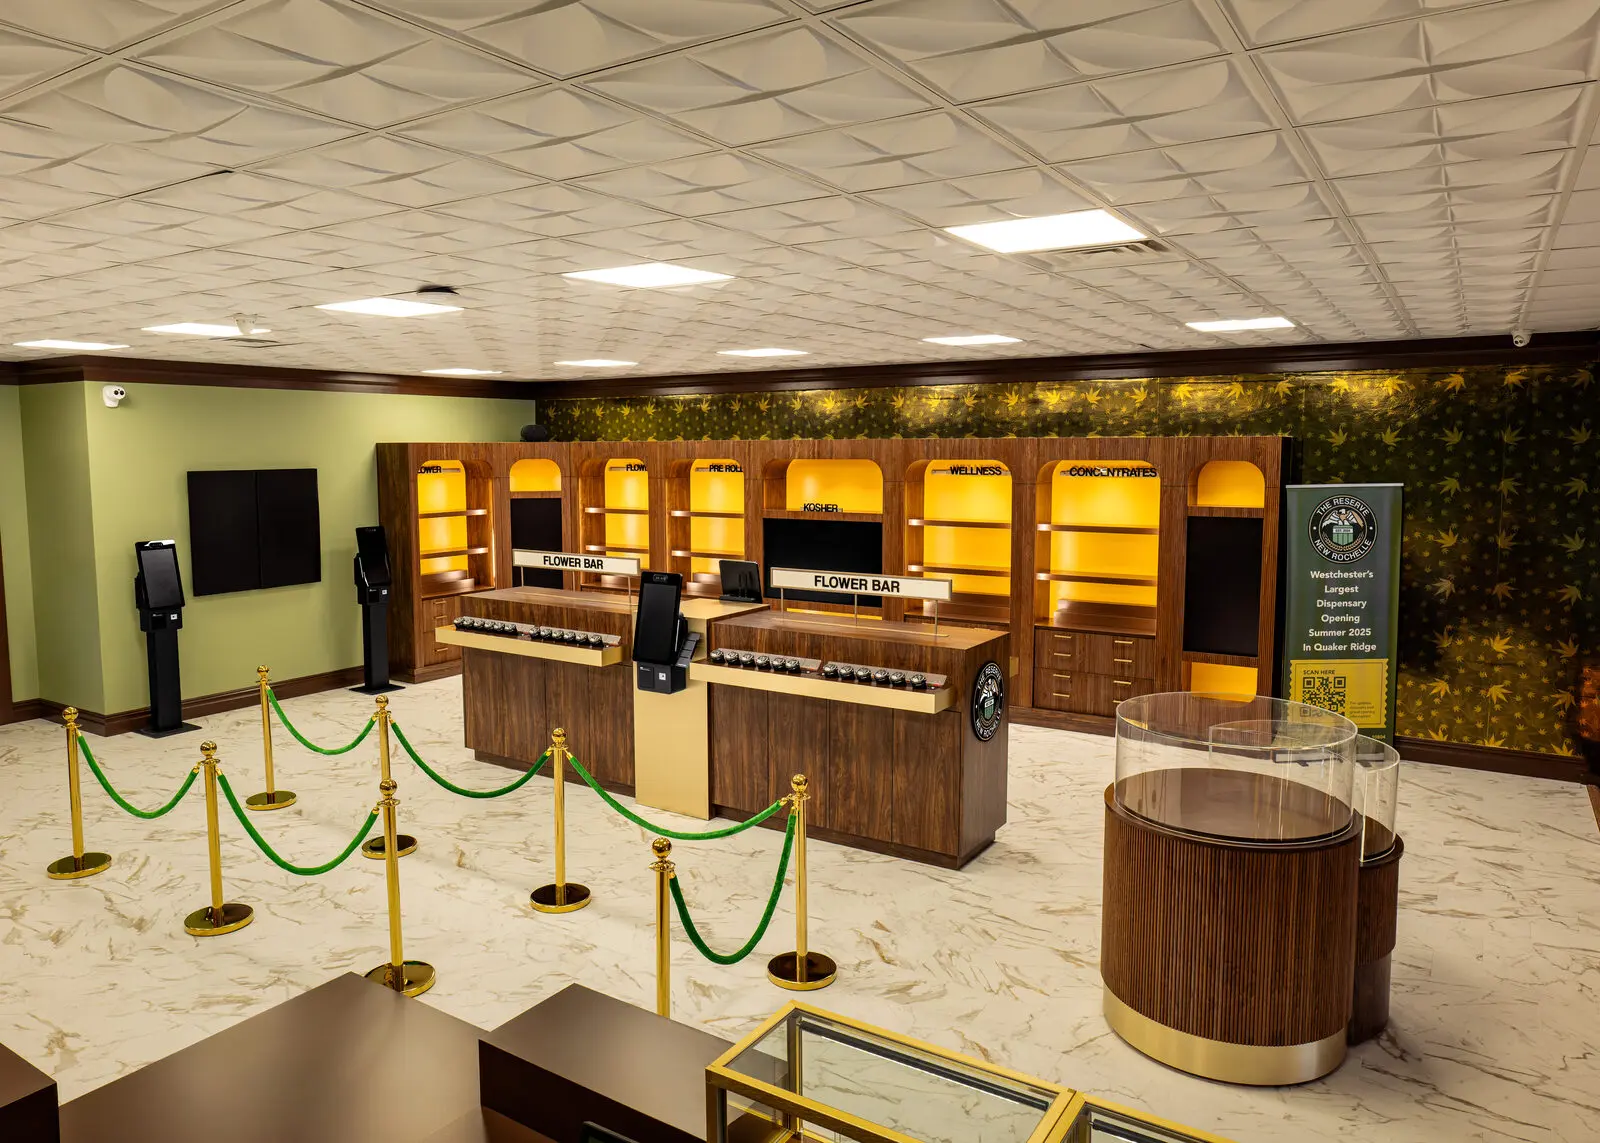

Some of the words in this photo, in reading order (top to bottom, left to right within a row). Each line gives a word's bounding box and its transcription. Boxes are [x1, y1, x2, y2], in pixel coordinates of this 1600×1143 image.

[950, 466, 1002, 476] WELLNESS
[1069, 466, 1158, 478] CONCENTRATES
[804, 503, 838, 512] KOSHER
[1316, 502, 1332, 516] THE
[1333, 498, 1370, 516] RESERVE
[1314, 539, 1331, 556] NEW
[1331, 540, 1372, 561] ROCHELLE
[543, 556, 580, 568] FLOWER
[584, 558, 604, 570] BAR
[1310, 570, 1374, 578] Westchester's
[814, 575, 868, 590] FLOWER
[872, 579, 900, 592] BAR
[1324, 585, 1359, 594] Largest
[1316, 600, 1367, 609] Dispensary
[1321, 614, 1360, 624] Opening
[1308, 628, 1346, 636] Summer
[1348, 628, 1372, 636] 2025
[1314, 643, 1348, 651] Quaker
[1350, 642, 1376, 652] Ridge
